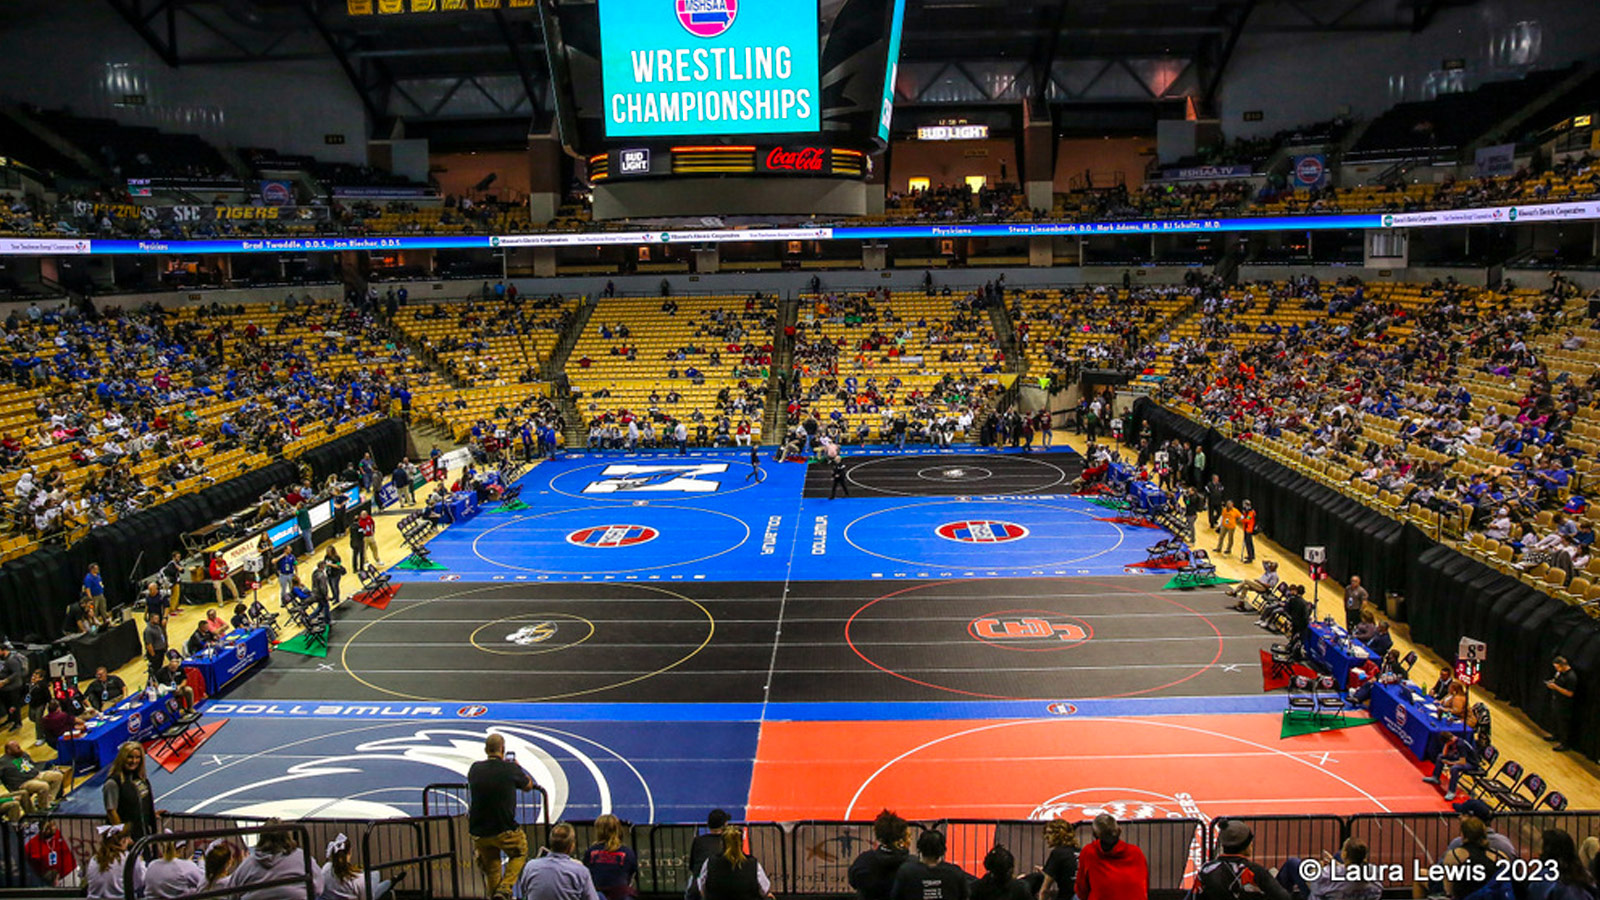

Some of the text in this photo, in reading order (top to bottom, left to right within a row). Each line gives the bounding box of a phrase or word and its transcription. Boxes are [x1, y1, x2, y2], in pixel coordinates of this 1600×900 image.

[631, 46, 792, 83] WRESTLING
[612, 89, 811, 124] CHAMPIONSHIPS
[917, 126, 988, 139] BUD LIGHT
[625, 151, 644, 163] BUD
[621, 160, 647, 171] LIGHT
[214, 206, 280, 220] TIGERS
[242, 241, 263, 250] Brad
[1466, 644, 1476, 659] 8
[58, 662, 67, 677] 7
[205, 704, 444, 716] DOLLAMUR
